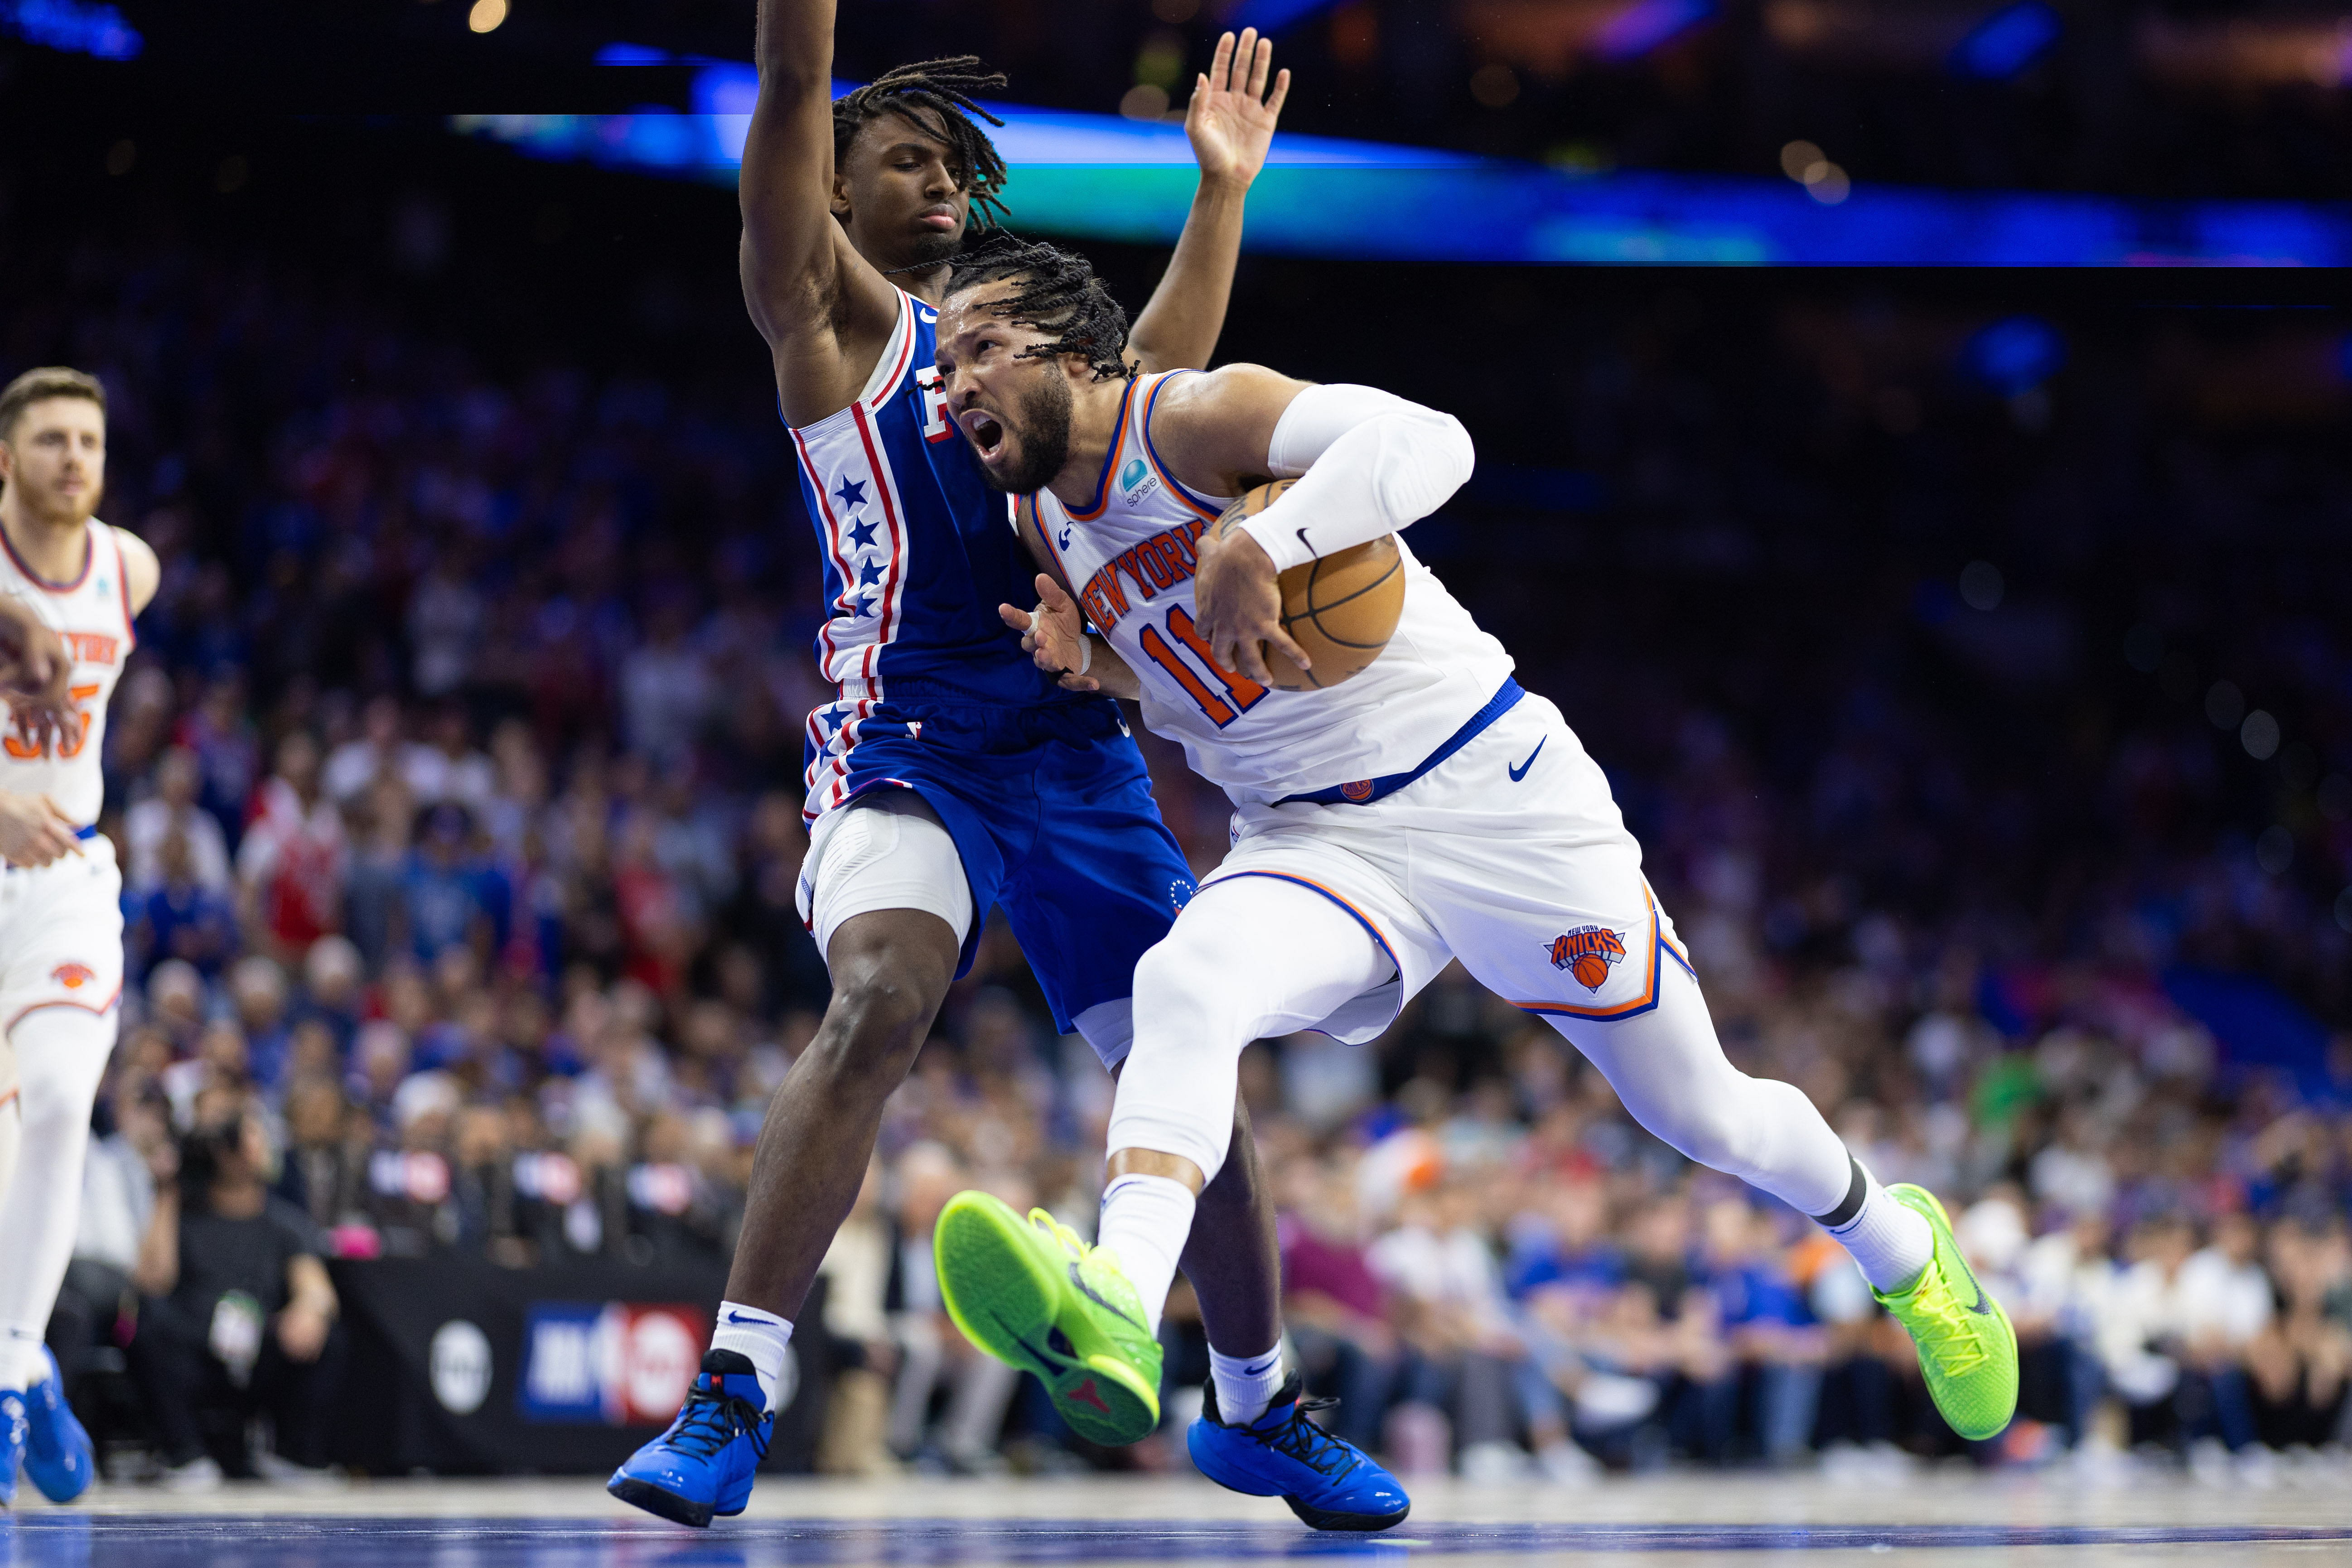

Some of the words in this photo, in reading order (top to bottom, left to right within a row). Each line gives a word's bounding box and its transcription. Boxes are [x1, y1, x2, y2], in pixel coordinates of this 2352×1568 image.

[1127, 478, 1157, 507] sphere
[1080, 559, 1132, 639] NEW
[1139, 603, 1270, 729] 11
[1550, 928, 1627, 965] KNICKS
[1568, 926, 1580, 936] NEW
